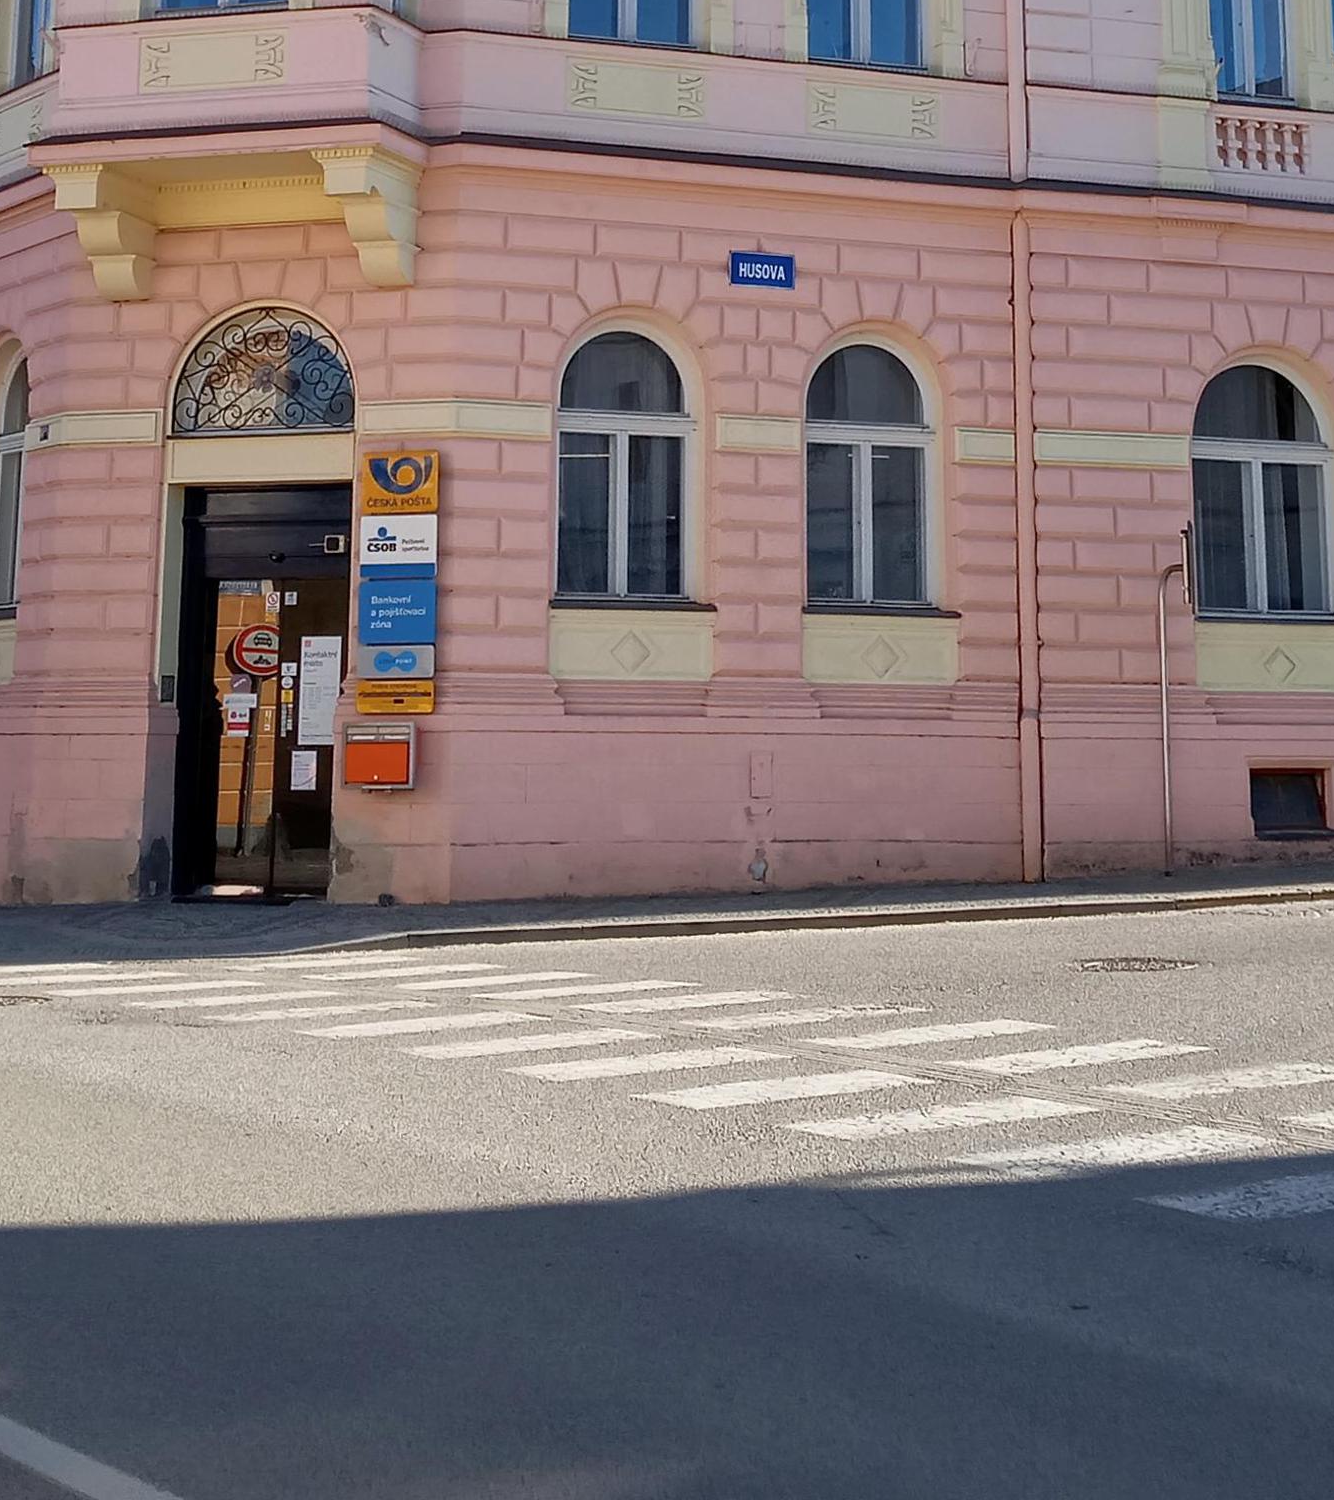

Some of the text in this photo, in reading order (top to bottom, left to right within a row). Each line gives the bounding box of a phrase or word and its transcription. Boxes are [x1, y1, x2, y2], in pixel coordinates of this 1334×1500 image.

[738, 262, 786, 281] HUSOVA
[367, 495, 432, 508] ČESKÁ POŠTA
[367, 541, 397, 553] ČSOB
[371, 595, 411, 605] Bankovní
[371, 607, 426, 618] a pojišťovací
[371, 620, 392, 629] zóna
